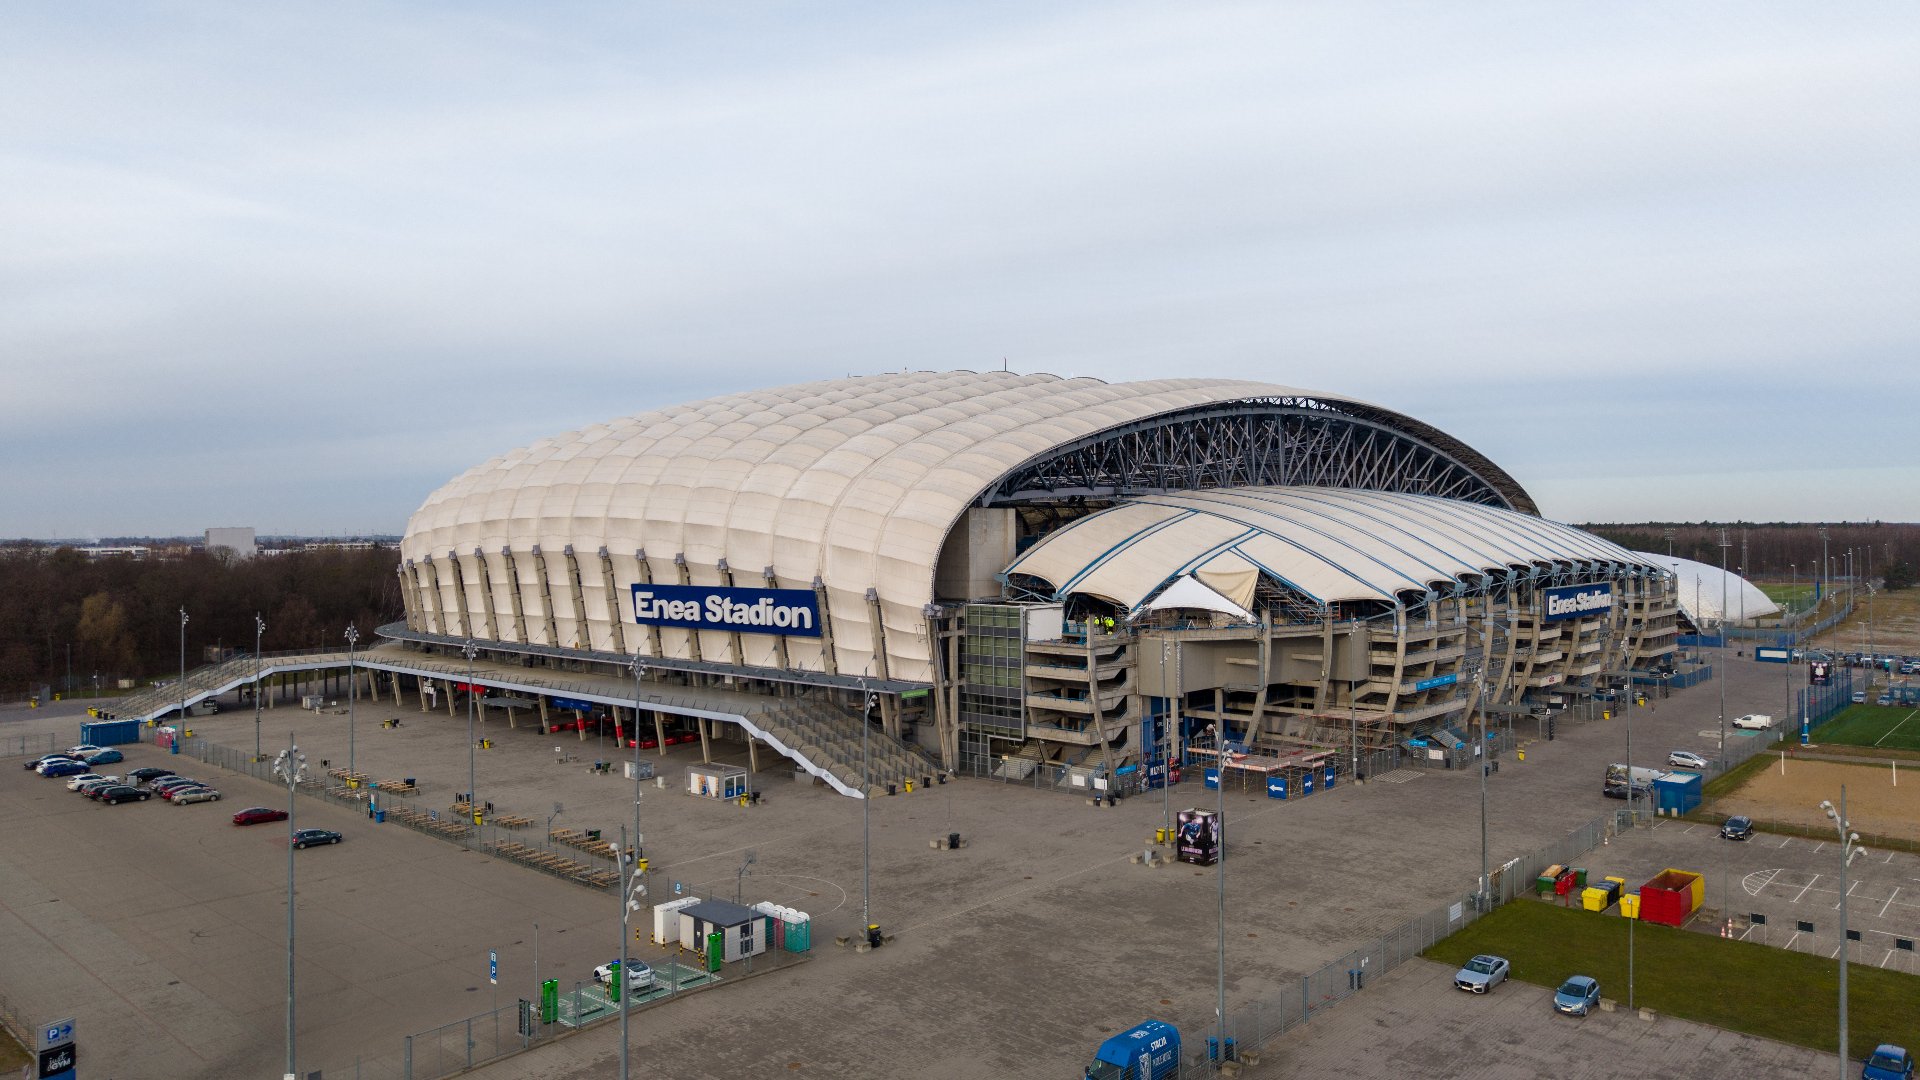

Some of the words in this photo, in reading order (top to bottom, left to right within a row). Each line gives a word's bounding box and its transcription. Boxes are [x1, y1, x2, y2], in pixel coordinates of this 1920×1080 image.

[635, 592, 701, 621] Enea
[705, 595, 812, 629] Stadion
[1549, 595, 1577, 615] Enea
[1577, 590, 1611, 611] Stadion
[49, 1029, 58, 1039] P
[1150, 1036, 1167, 1052] STACJA
[51, 1058, 71, 1070] GYM
